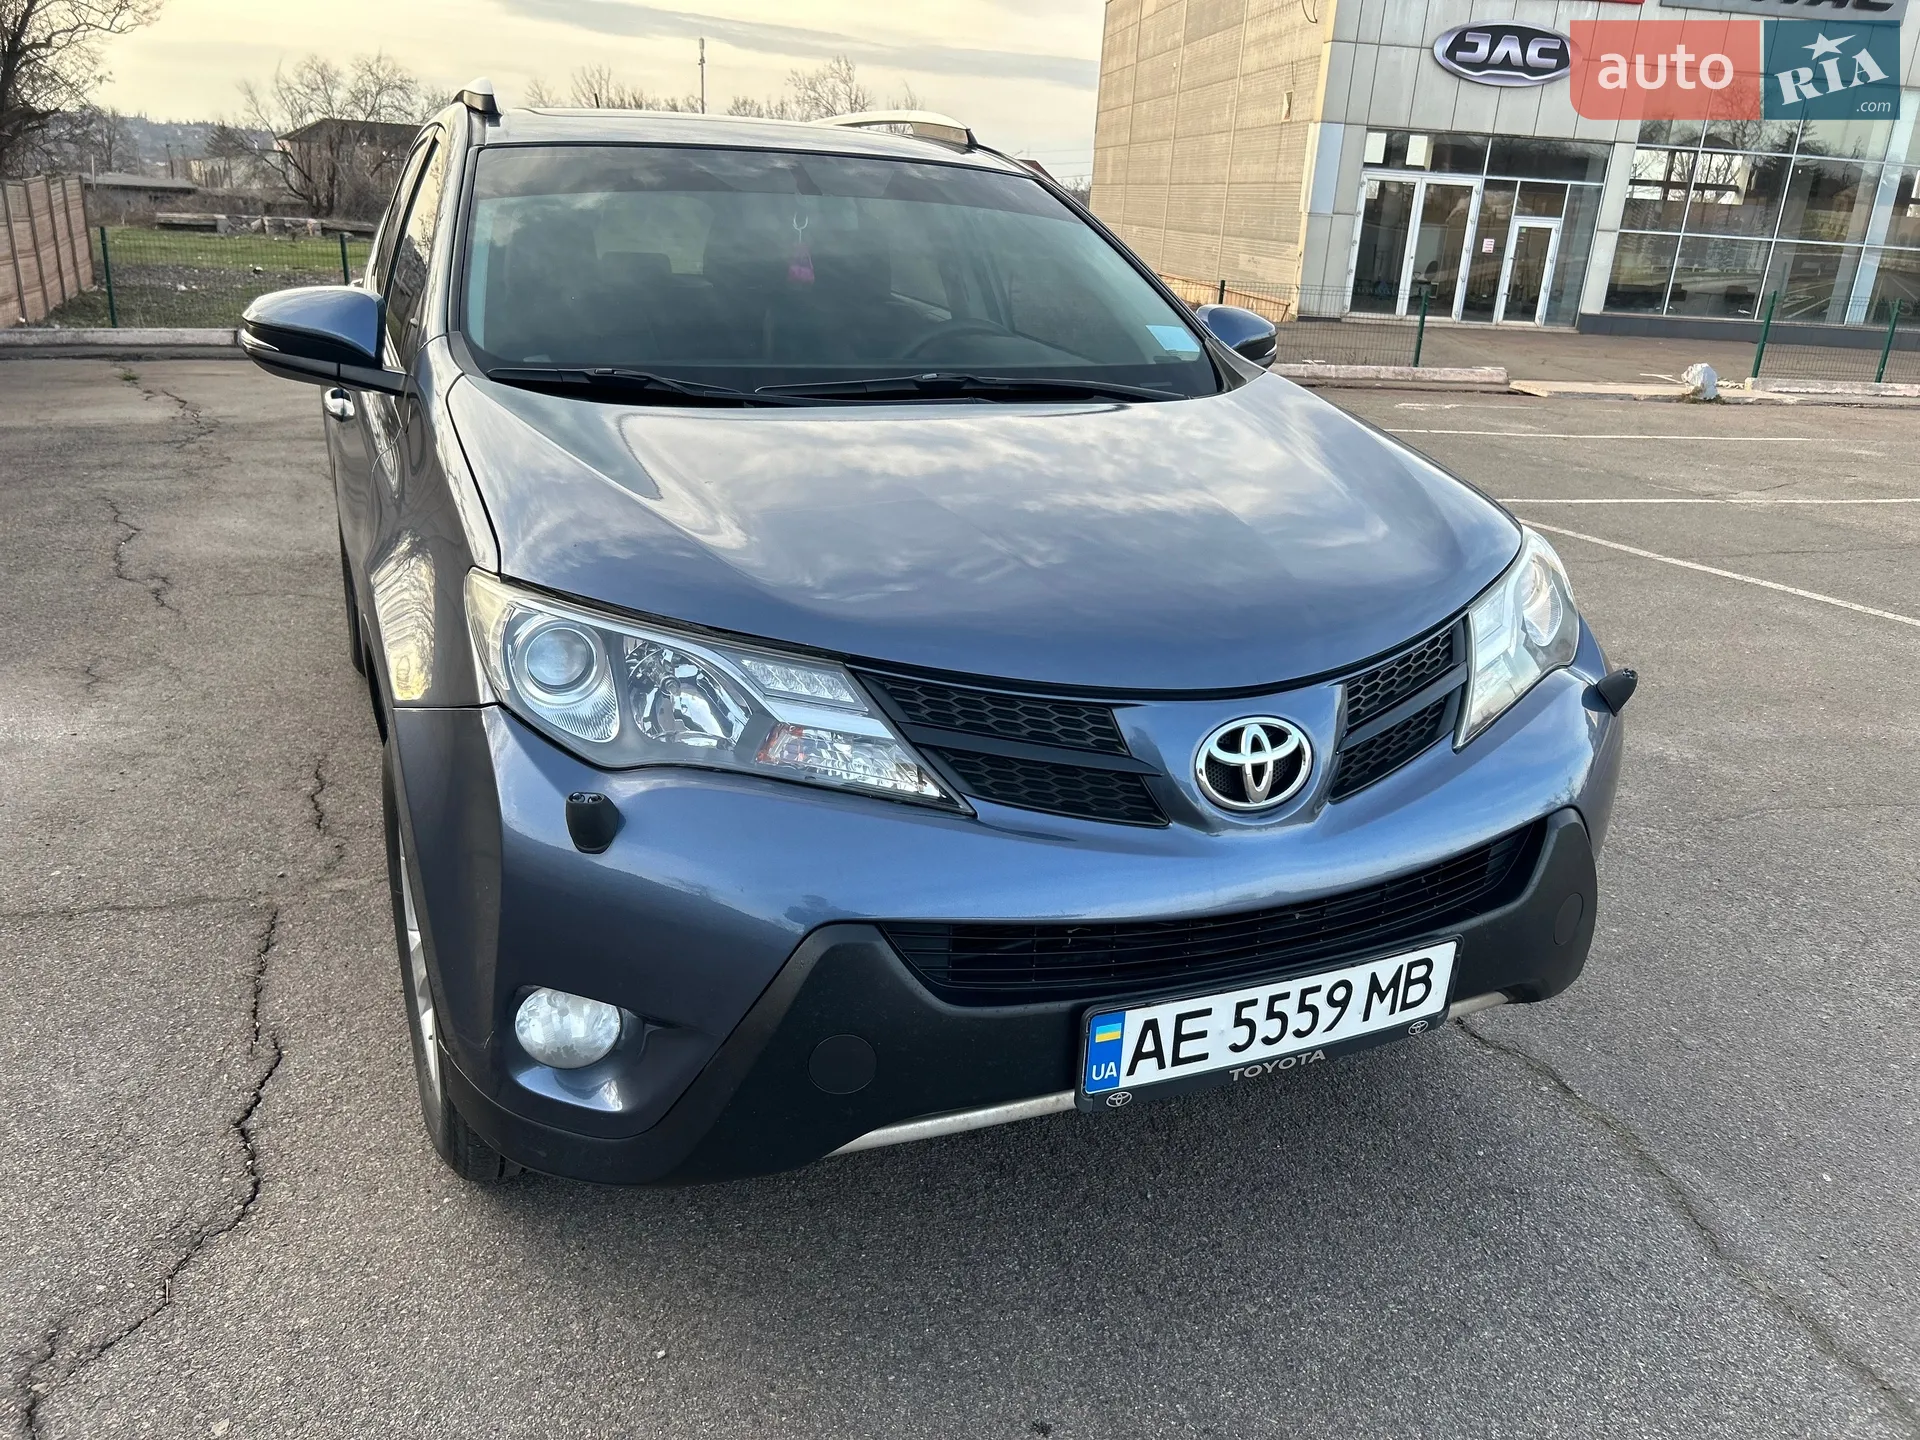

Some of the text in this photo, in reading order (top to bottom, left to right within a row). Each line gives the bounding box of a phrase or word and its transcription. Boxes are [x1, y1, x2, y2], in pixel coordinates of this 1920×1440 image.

[1455, 32, 1561, 69] JAC
[1126, 956, 1434, 1077] AE 5559 MB
[1092, 1061, 1117, 1081] UA
[1229, 1049, 1326, 1082] TOYOTA
